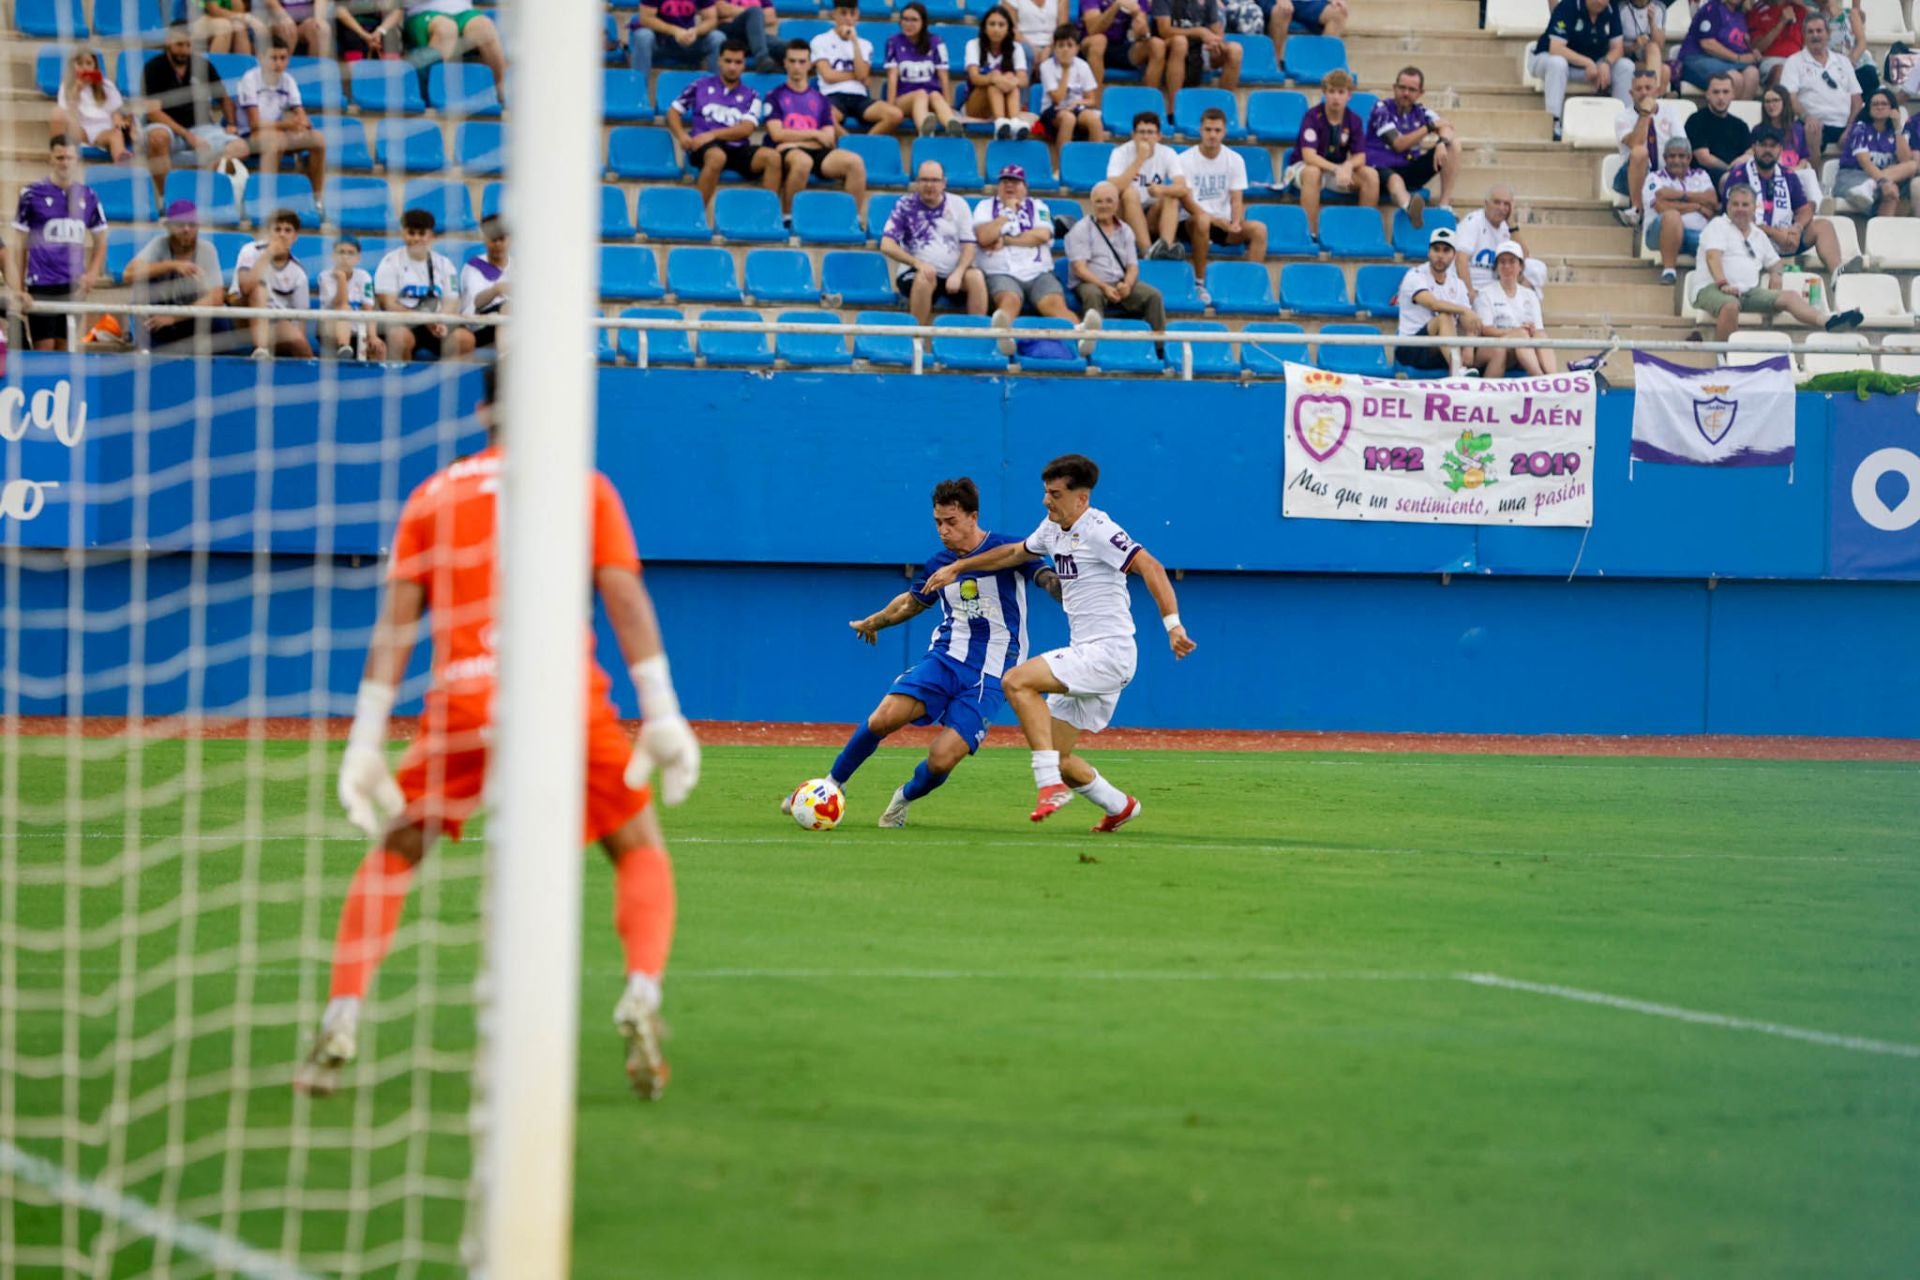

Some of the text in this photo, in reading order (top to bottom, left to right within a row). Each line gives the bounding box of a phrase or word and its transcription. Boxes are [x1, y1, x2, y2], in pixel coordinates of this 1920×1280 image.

[1479, 376, 1591, 393] AMIGOS
[1362, 397, 1413, 418] DEL
[1363, 446, 1581, 478] 1922 2019
[1288, 467, 1586, 517] Mas que un sentimiento, una pasión
